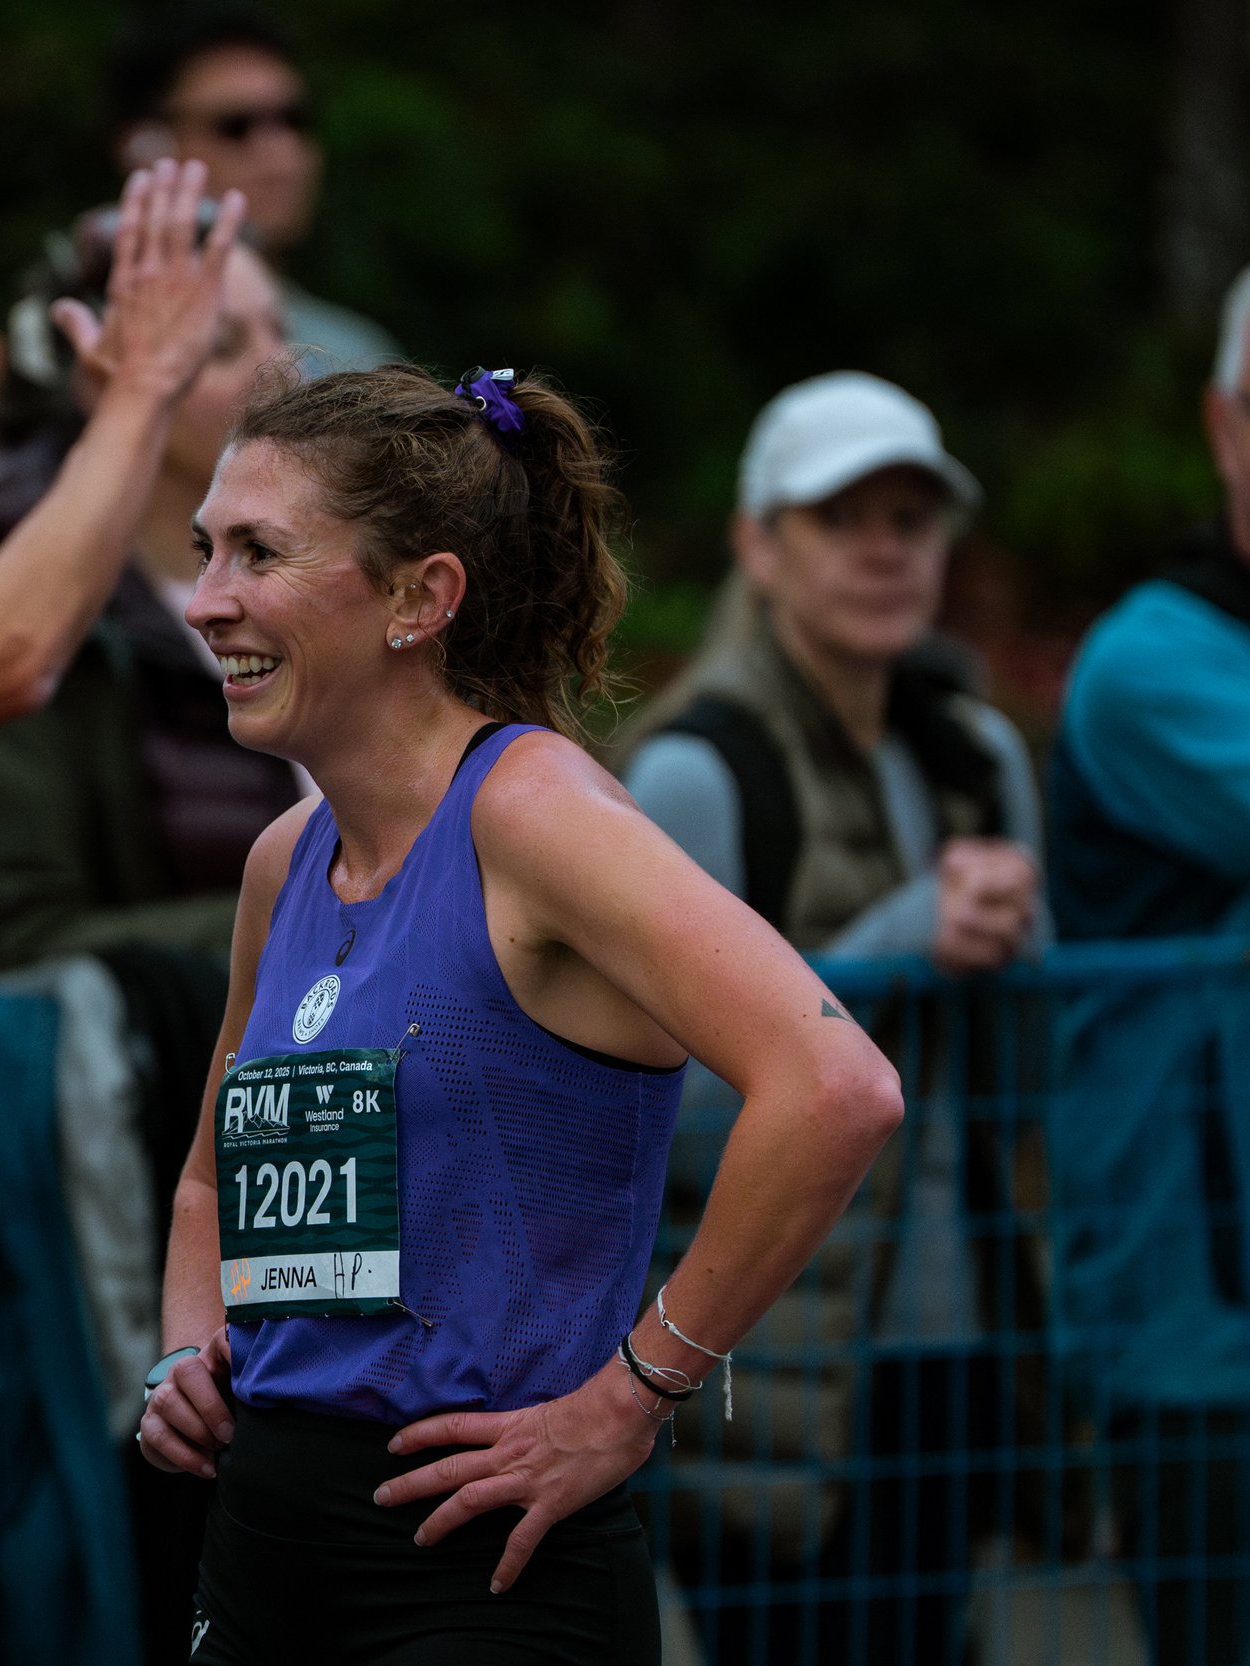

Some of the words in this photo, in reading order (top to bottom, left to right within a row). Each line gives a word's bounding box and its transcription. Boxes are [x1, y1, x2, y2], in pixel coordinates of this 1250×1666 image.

[301, 979, 338, 1010] BACKROADS
[238, 1070, 263, 1081] October
[264, 1069, 274, 1080] 12,
[274, 1066, 290, 1078] 2025
[298, 1063, 325, 1076] Victoria,
[326, 1063, 338, 1075] BC,
[339, 1060, 373, 1072] Canada
[225, 1083, 291, 1133] RVM
[352, 1089, 381, 1114] 8K
[305, 1107, 344, 1123] Westland
[310, 1123, 340, 1133] Insurance
[239, 1139, 261, 1147] VICTORIA
[262, 1137, 288, 1145] MARATHON
[234, 1157, 357, 1230] 12021
[261, 1266, 317, 1291] JENNA
